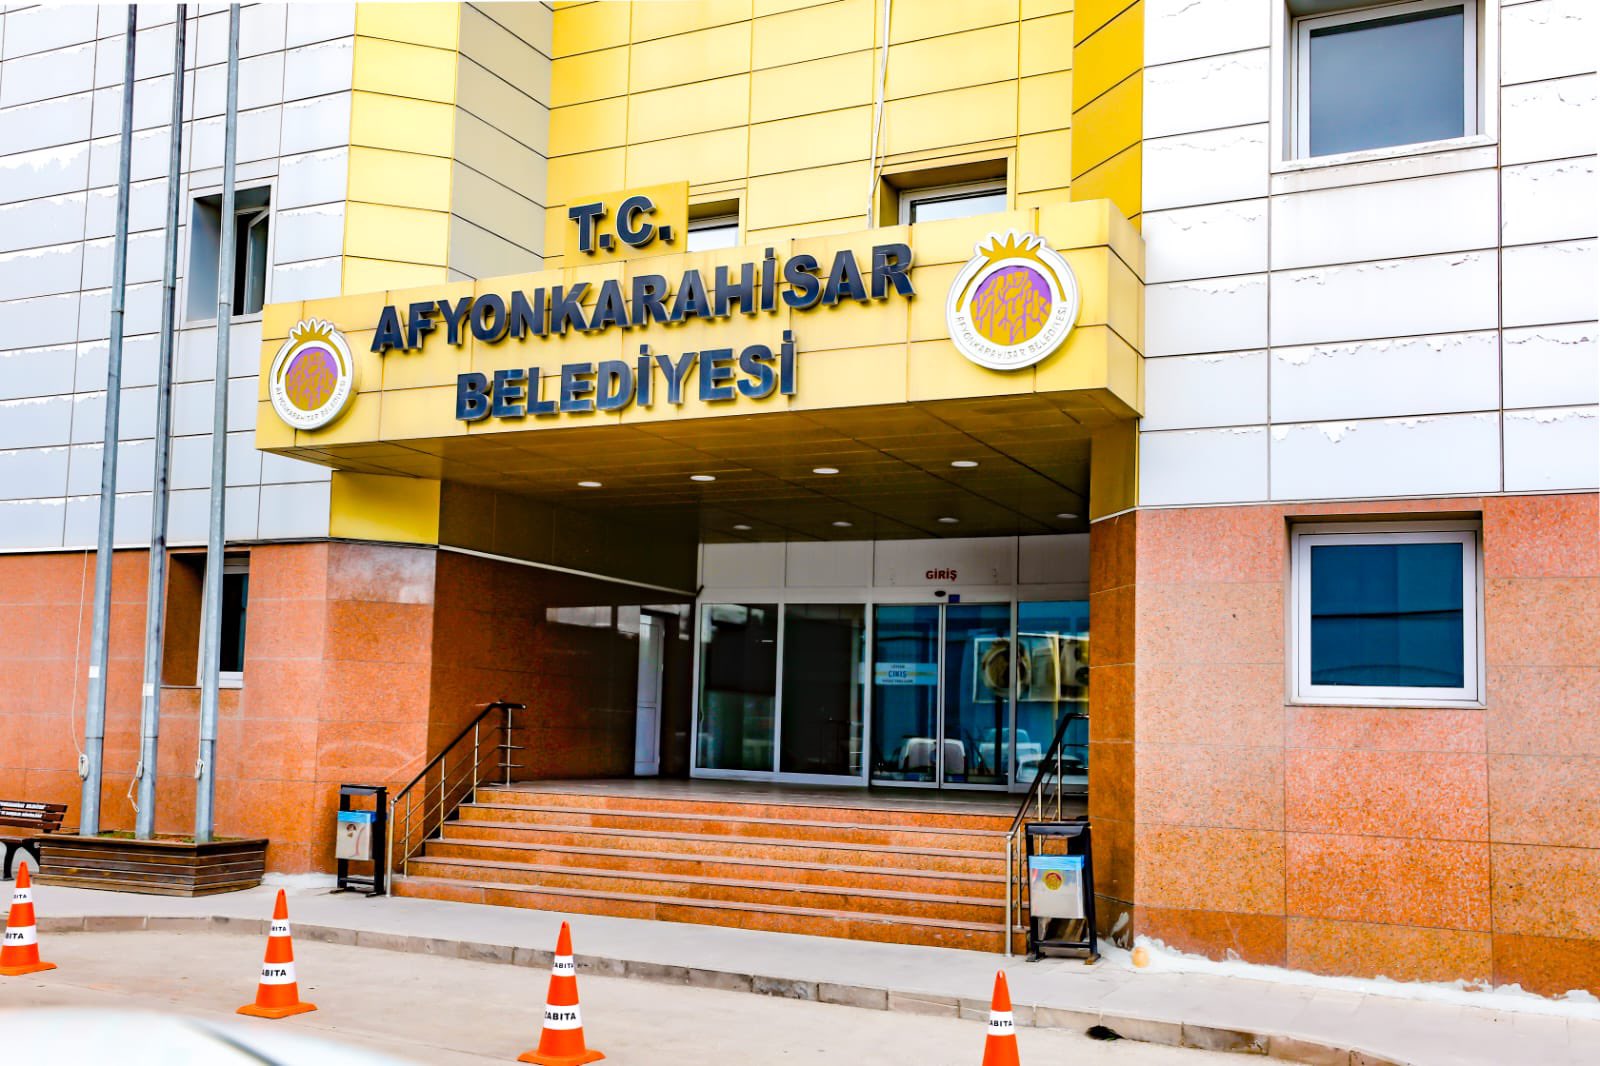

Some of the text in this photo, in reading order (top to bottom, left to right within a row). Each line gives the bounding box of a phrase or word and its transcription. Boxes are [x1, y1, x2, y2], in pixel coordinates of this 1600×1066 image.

[568, 195, 674, 254] T.C.
[370, 243, 916, 353] AFYONKARAHİSAR
[455, 329, 799, 421] BELEDİYESİ
[926, 568, 957, 581] GİRİŞ
